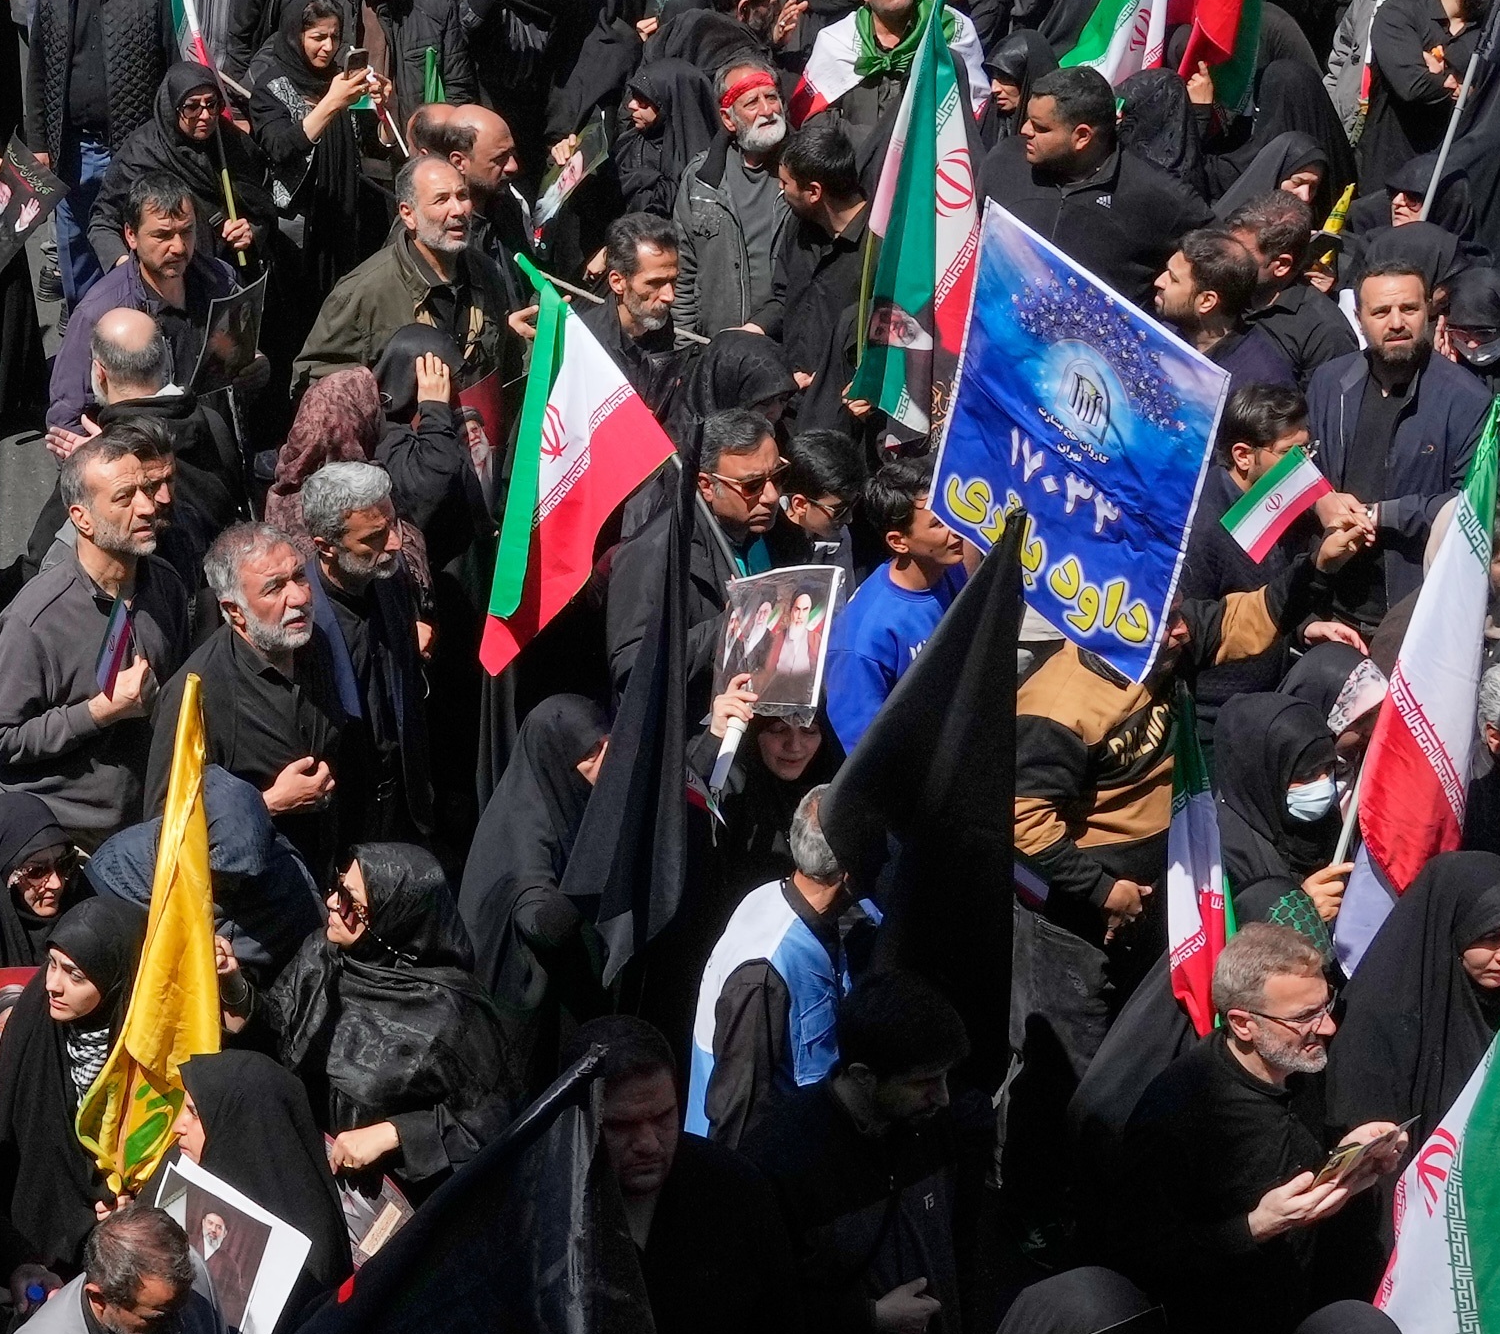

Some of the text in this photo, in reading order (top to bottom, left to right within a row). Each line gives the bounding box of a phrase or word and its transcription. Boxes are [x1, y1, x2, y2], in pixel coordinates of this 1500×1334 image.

[1038, 406, 1111, 464] کاروان حج بشارت
[1057, 442, 1083, 463] تهران
[1049, 558, 1149, 643] داود
